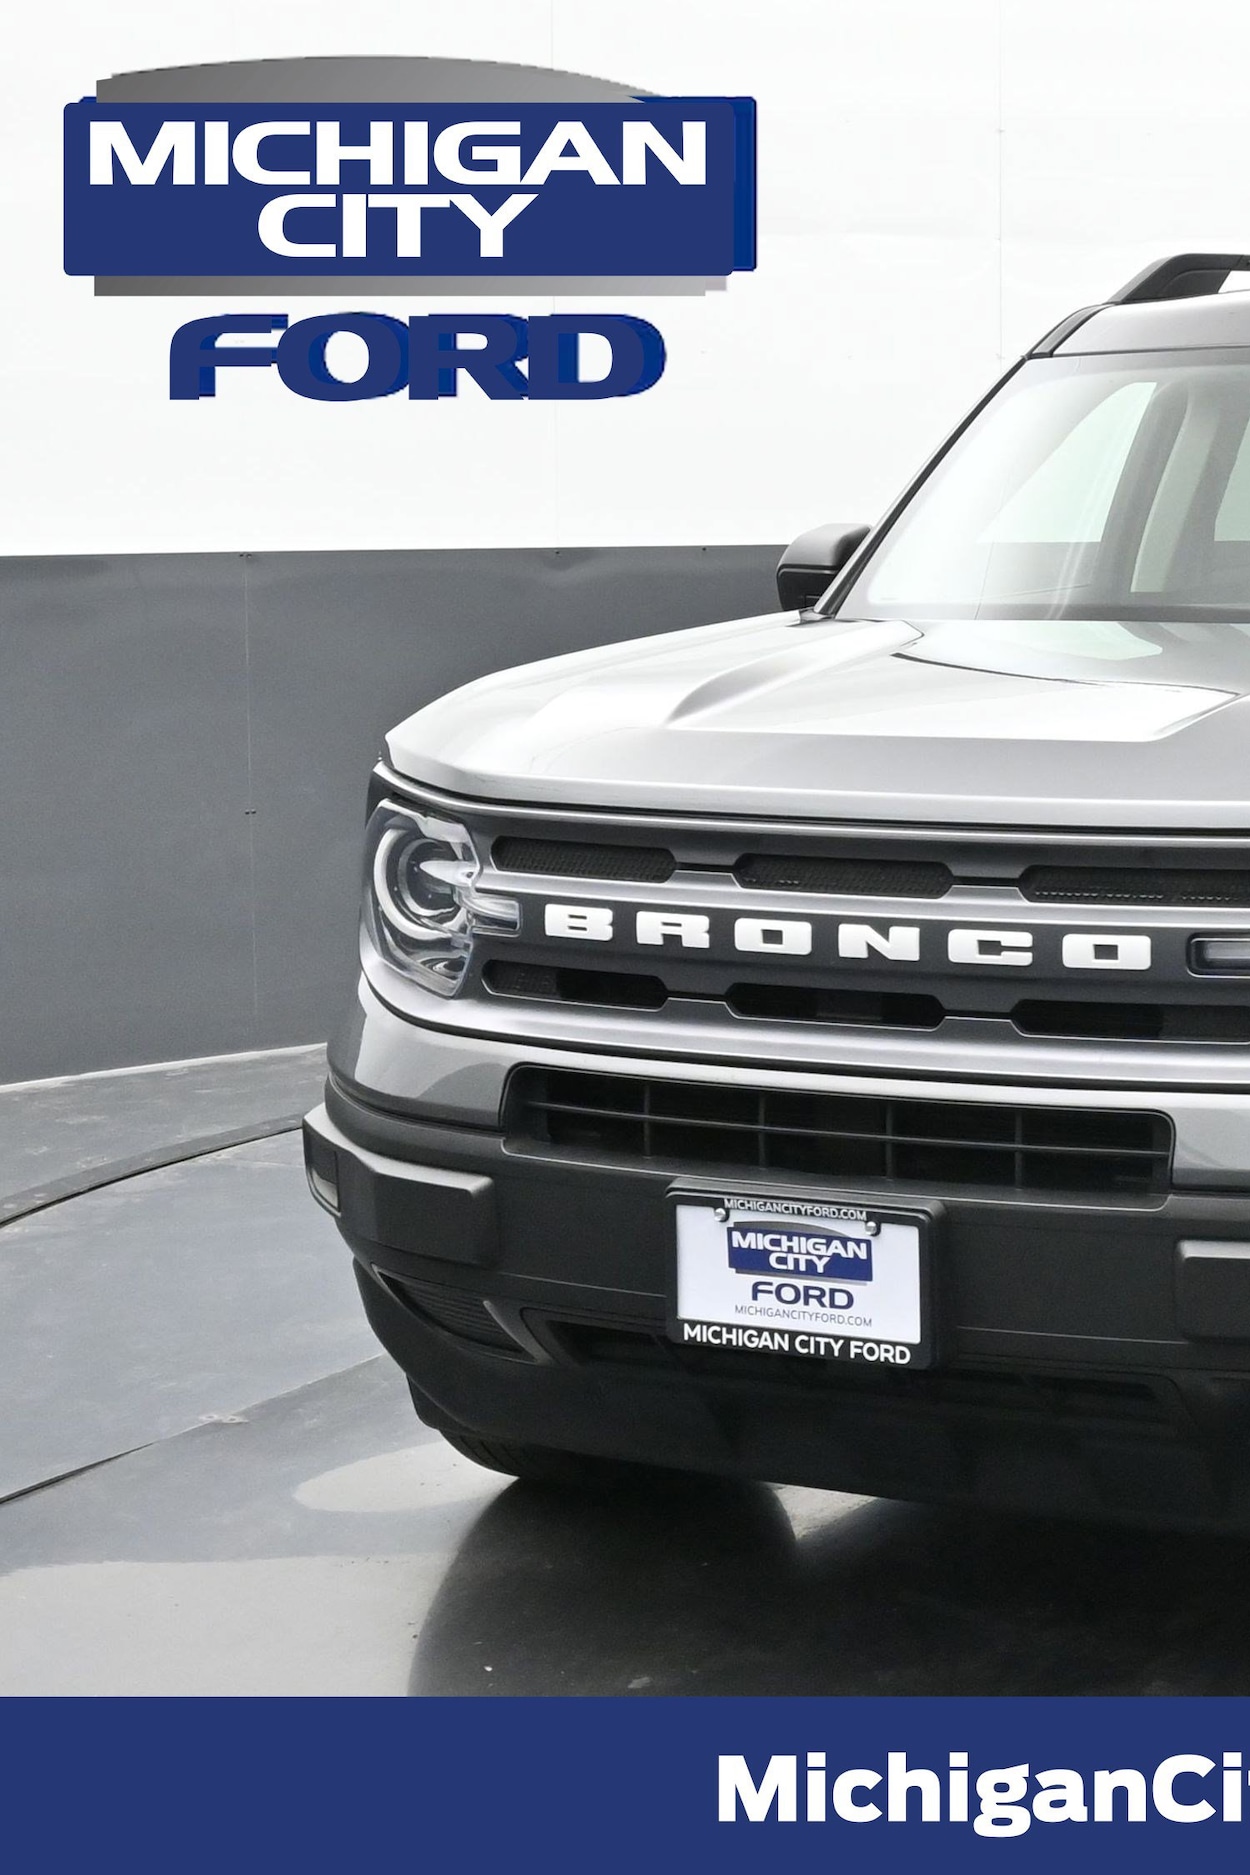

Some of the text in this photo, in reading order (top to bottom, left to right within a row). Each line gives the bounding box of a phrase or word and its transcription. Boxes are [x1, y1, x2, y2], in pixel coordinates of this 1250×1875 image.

[544, 903, 1152, 970] BRONCO
[724, 1198, 867, 1221] MICHIGANCITYFORD.COM
[731, 1231, 868, 1260] MICHIGAN
[768, 1252, 831, 1273] CITY
[751, 1281, 854, 1310] FORD
[734, 1304, 873, 1327] MICHIGANCITYFORD.COM
[683, 1323, 912, 1365] MICHIGAN CITY FORD
